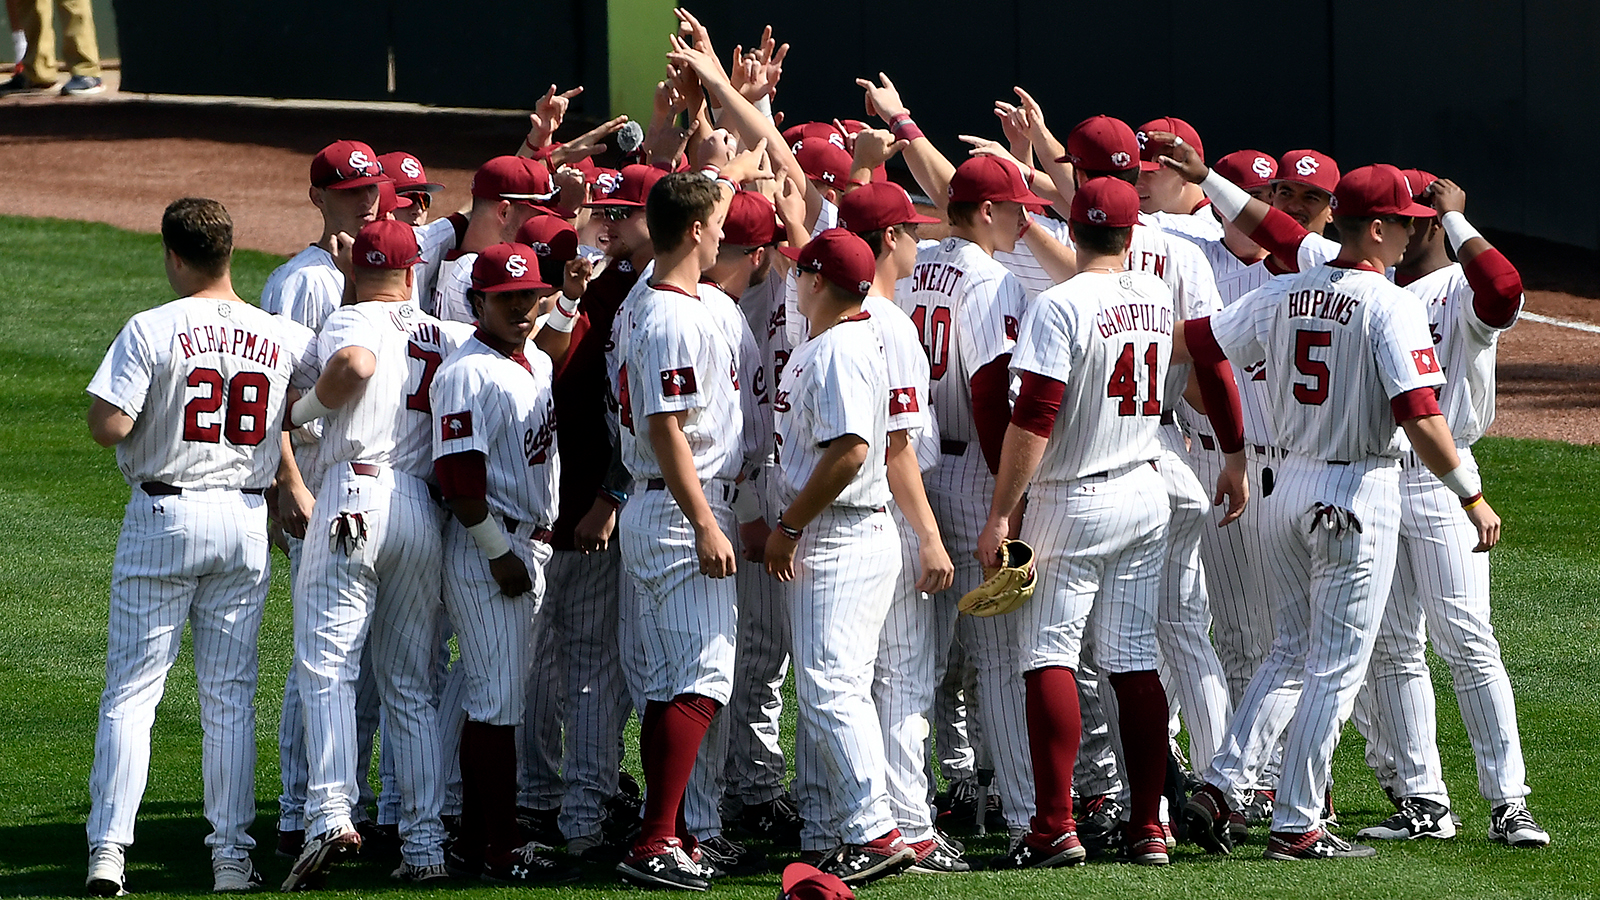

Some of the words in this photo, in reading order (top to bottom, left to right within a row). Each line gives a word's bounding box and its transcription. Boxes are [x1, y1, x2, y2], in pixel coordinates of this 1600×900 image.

[1096, 303, 1171, 339] GANOPULOS
[1288, 289, 1360, 326] HOPKINS
[177, 325, 281, 370] RCHAPMAN
[1292, 329, 1332, 406] 5
[182, 366, 271, 447] 28
[1107, 341, 1161, 417] 41
